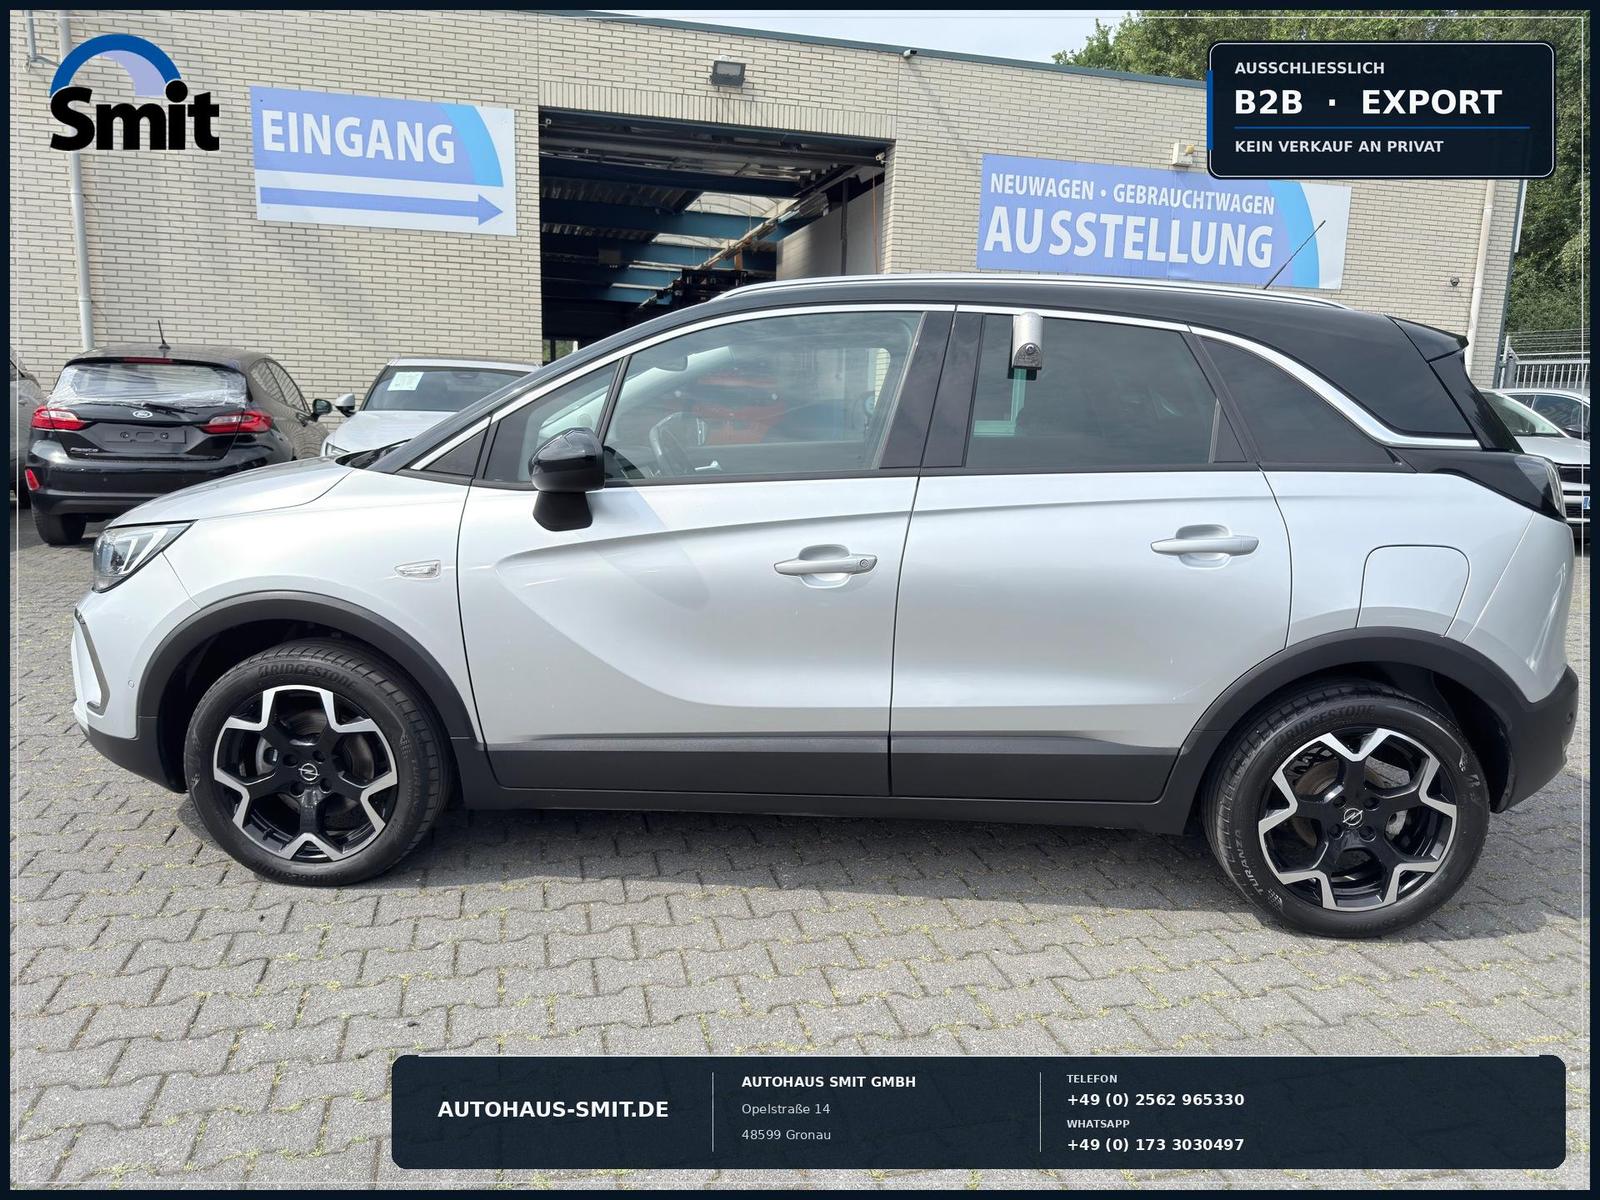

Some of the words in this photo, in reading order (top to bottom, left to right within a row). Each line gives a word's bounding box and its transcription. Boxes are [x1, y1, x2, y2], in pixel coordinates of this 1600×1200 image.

[262, 110, 455, 164] EINGANG
[990, 173, 1094, 200] NEUWAGEN
[1113, 183, 1275, 215] GEBRAUCHTWAGEN
[983, 206, 1273, 268] AUSSTELLUNG
